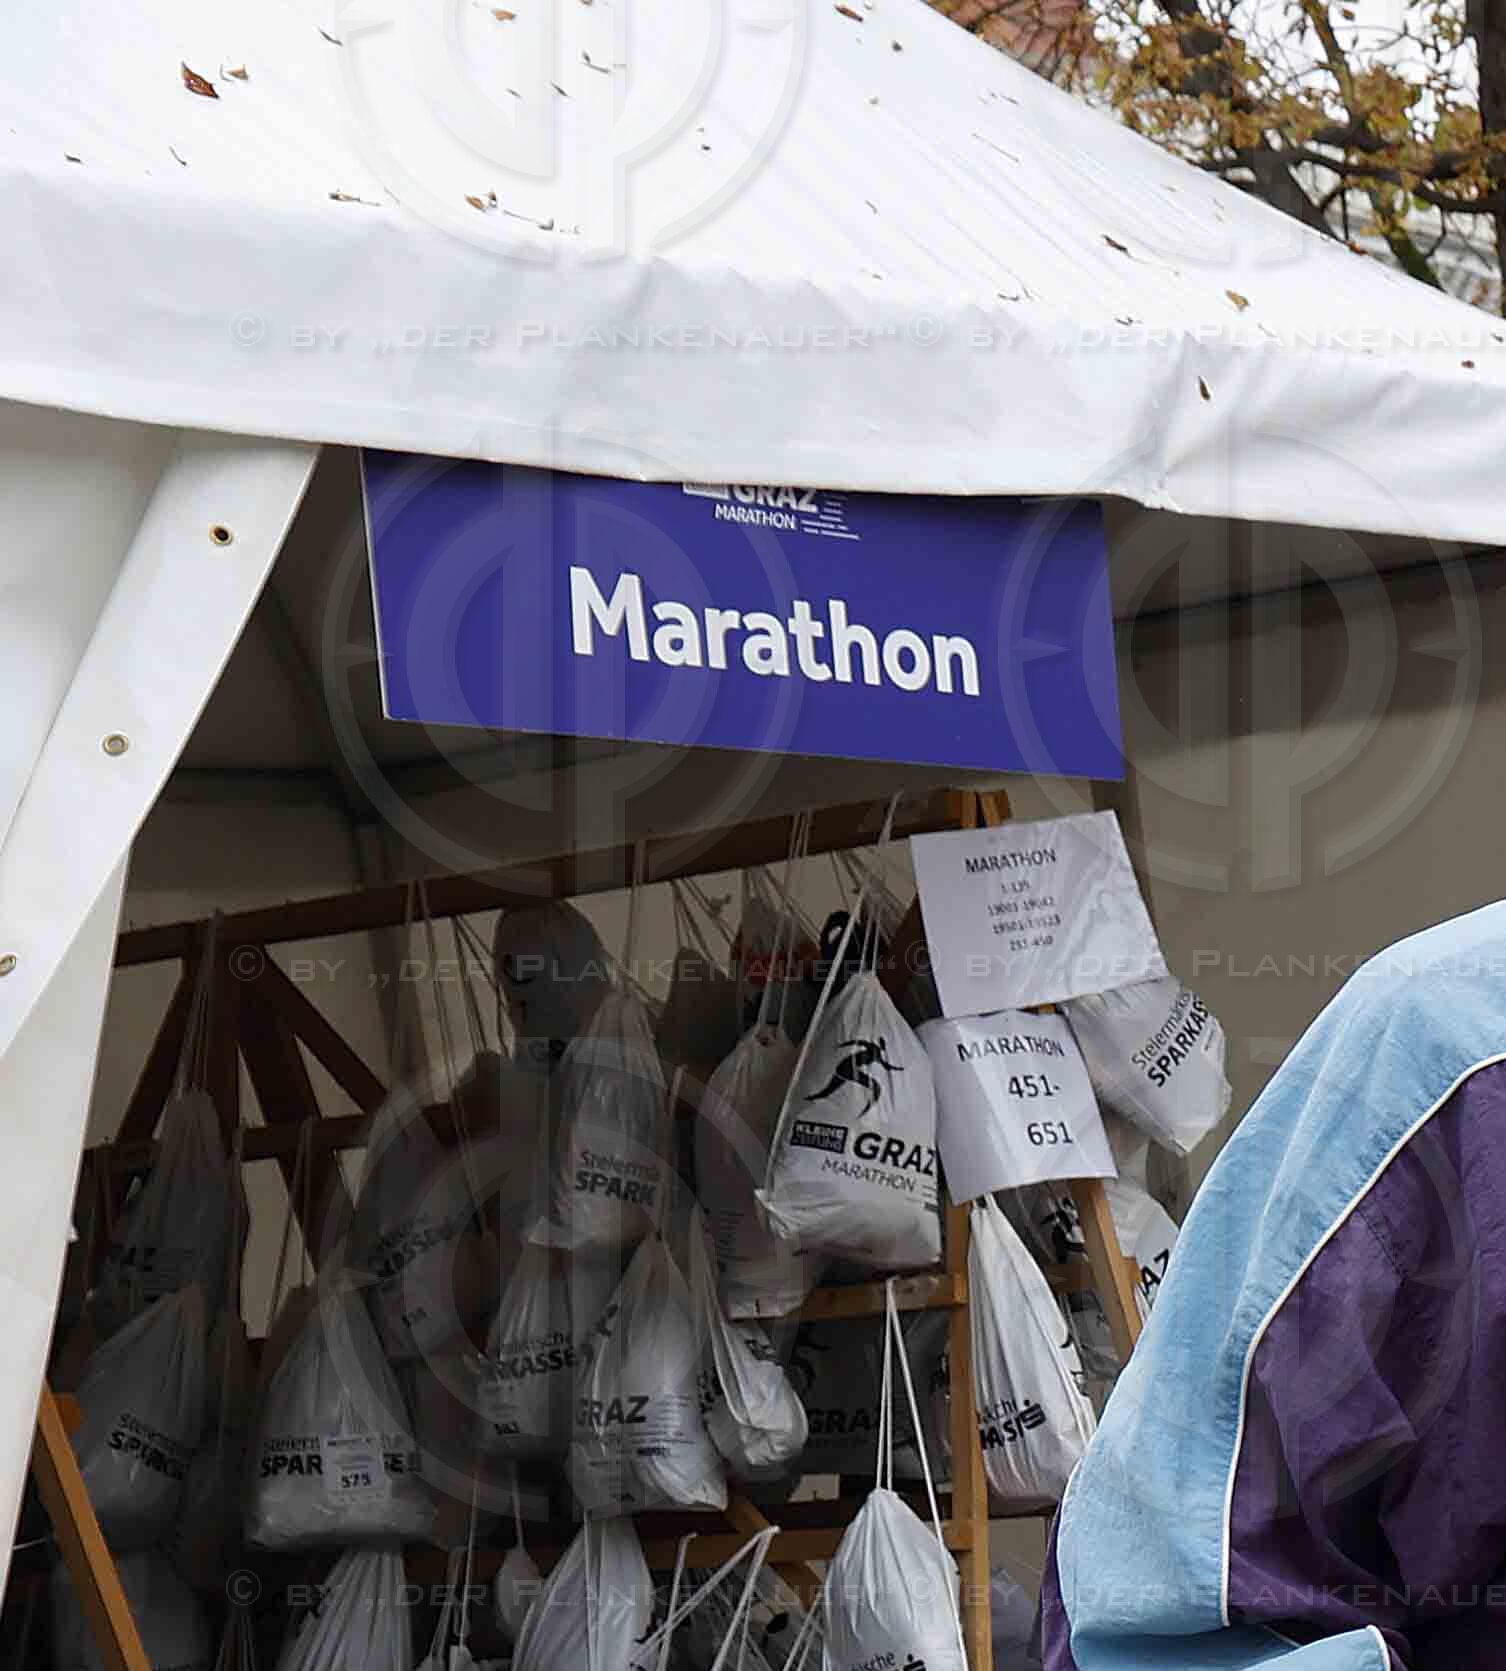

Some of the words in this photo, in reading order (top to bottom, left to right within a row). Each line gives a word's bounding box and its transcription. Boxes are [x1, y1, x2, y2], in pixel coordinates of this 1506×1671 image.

[714, 503, 797, 529] MARATHON
[569, 565, 981, 697] Marathon
[964, 848, 1058, 873] MARATHON
[957, 1033, 1064, 1062] MARATHON
[1027, 1120, 1073, 1147] 651
[853, 1131, 937, 1178] GRAZ
[821, 1156, 916, 1194] MARATHON
